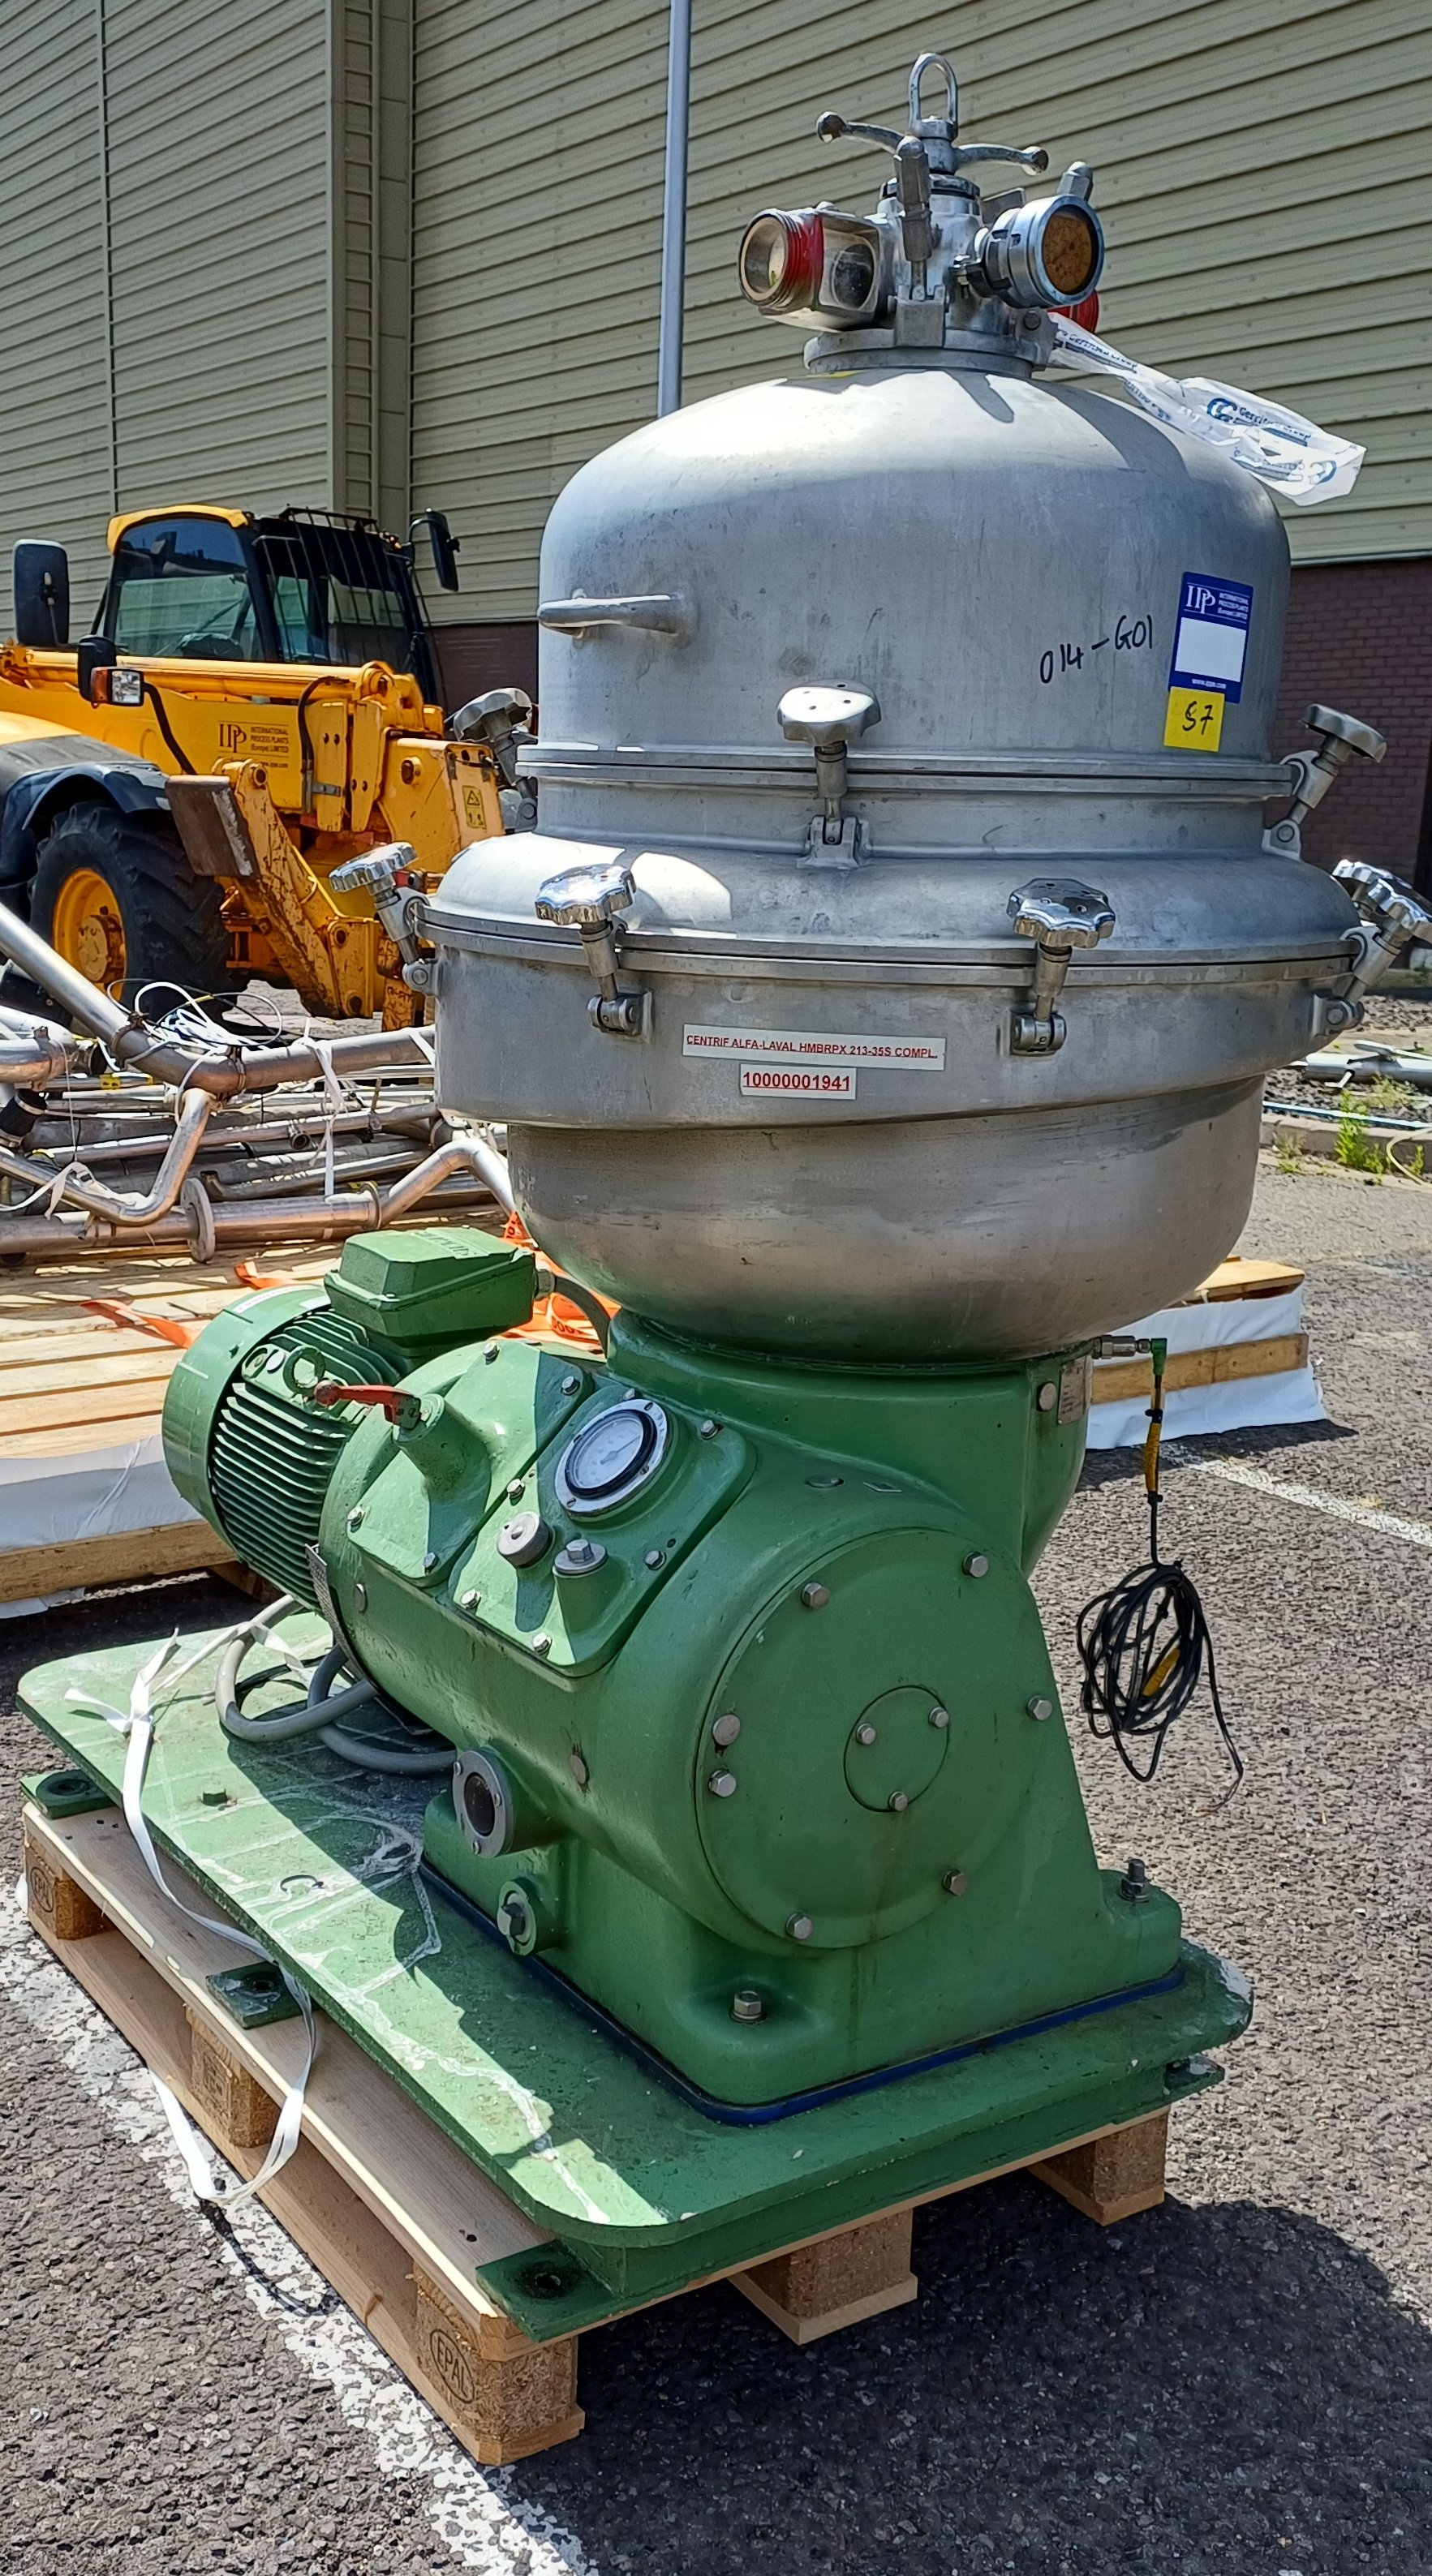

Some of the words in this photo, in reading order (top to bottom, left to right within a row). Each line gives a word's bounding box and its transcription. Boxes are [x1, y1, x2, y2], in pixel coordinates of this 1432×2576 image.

[732, 1038, 796, 1052] ALFA-LAVAL
[800, 1043, 847, 1054] HMBRPX
[850, 1045, 892, 1056] 213-35S
[895, 1047, 938, 1058] COMPL.
[742, 1071, 851, 1091] 10000001941
[437, 2335, 468, 2398] EPAL
